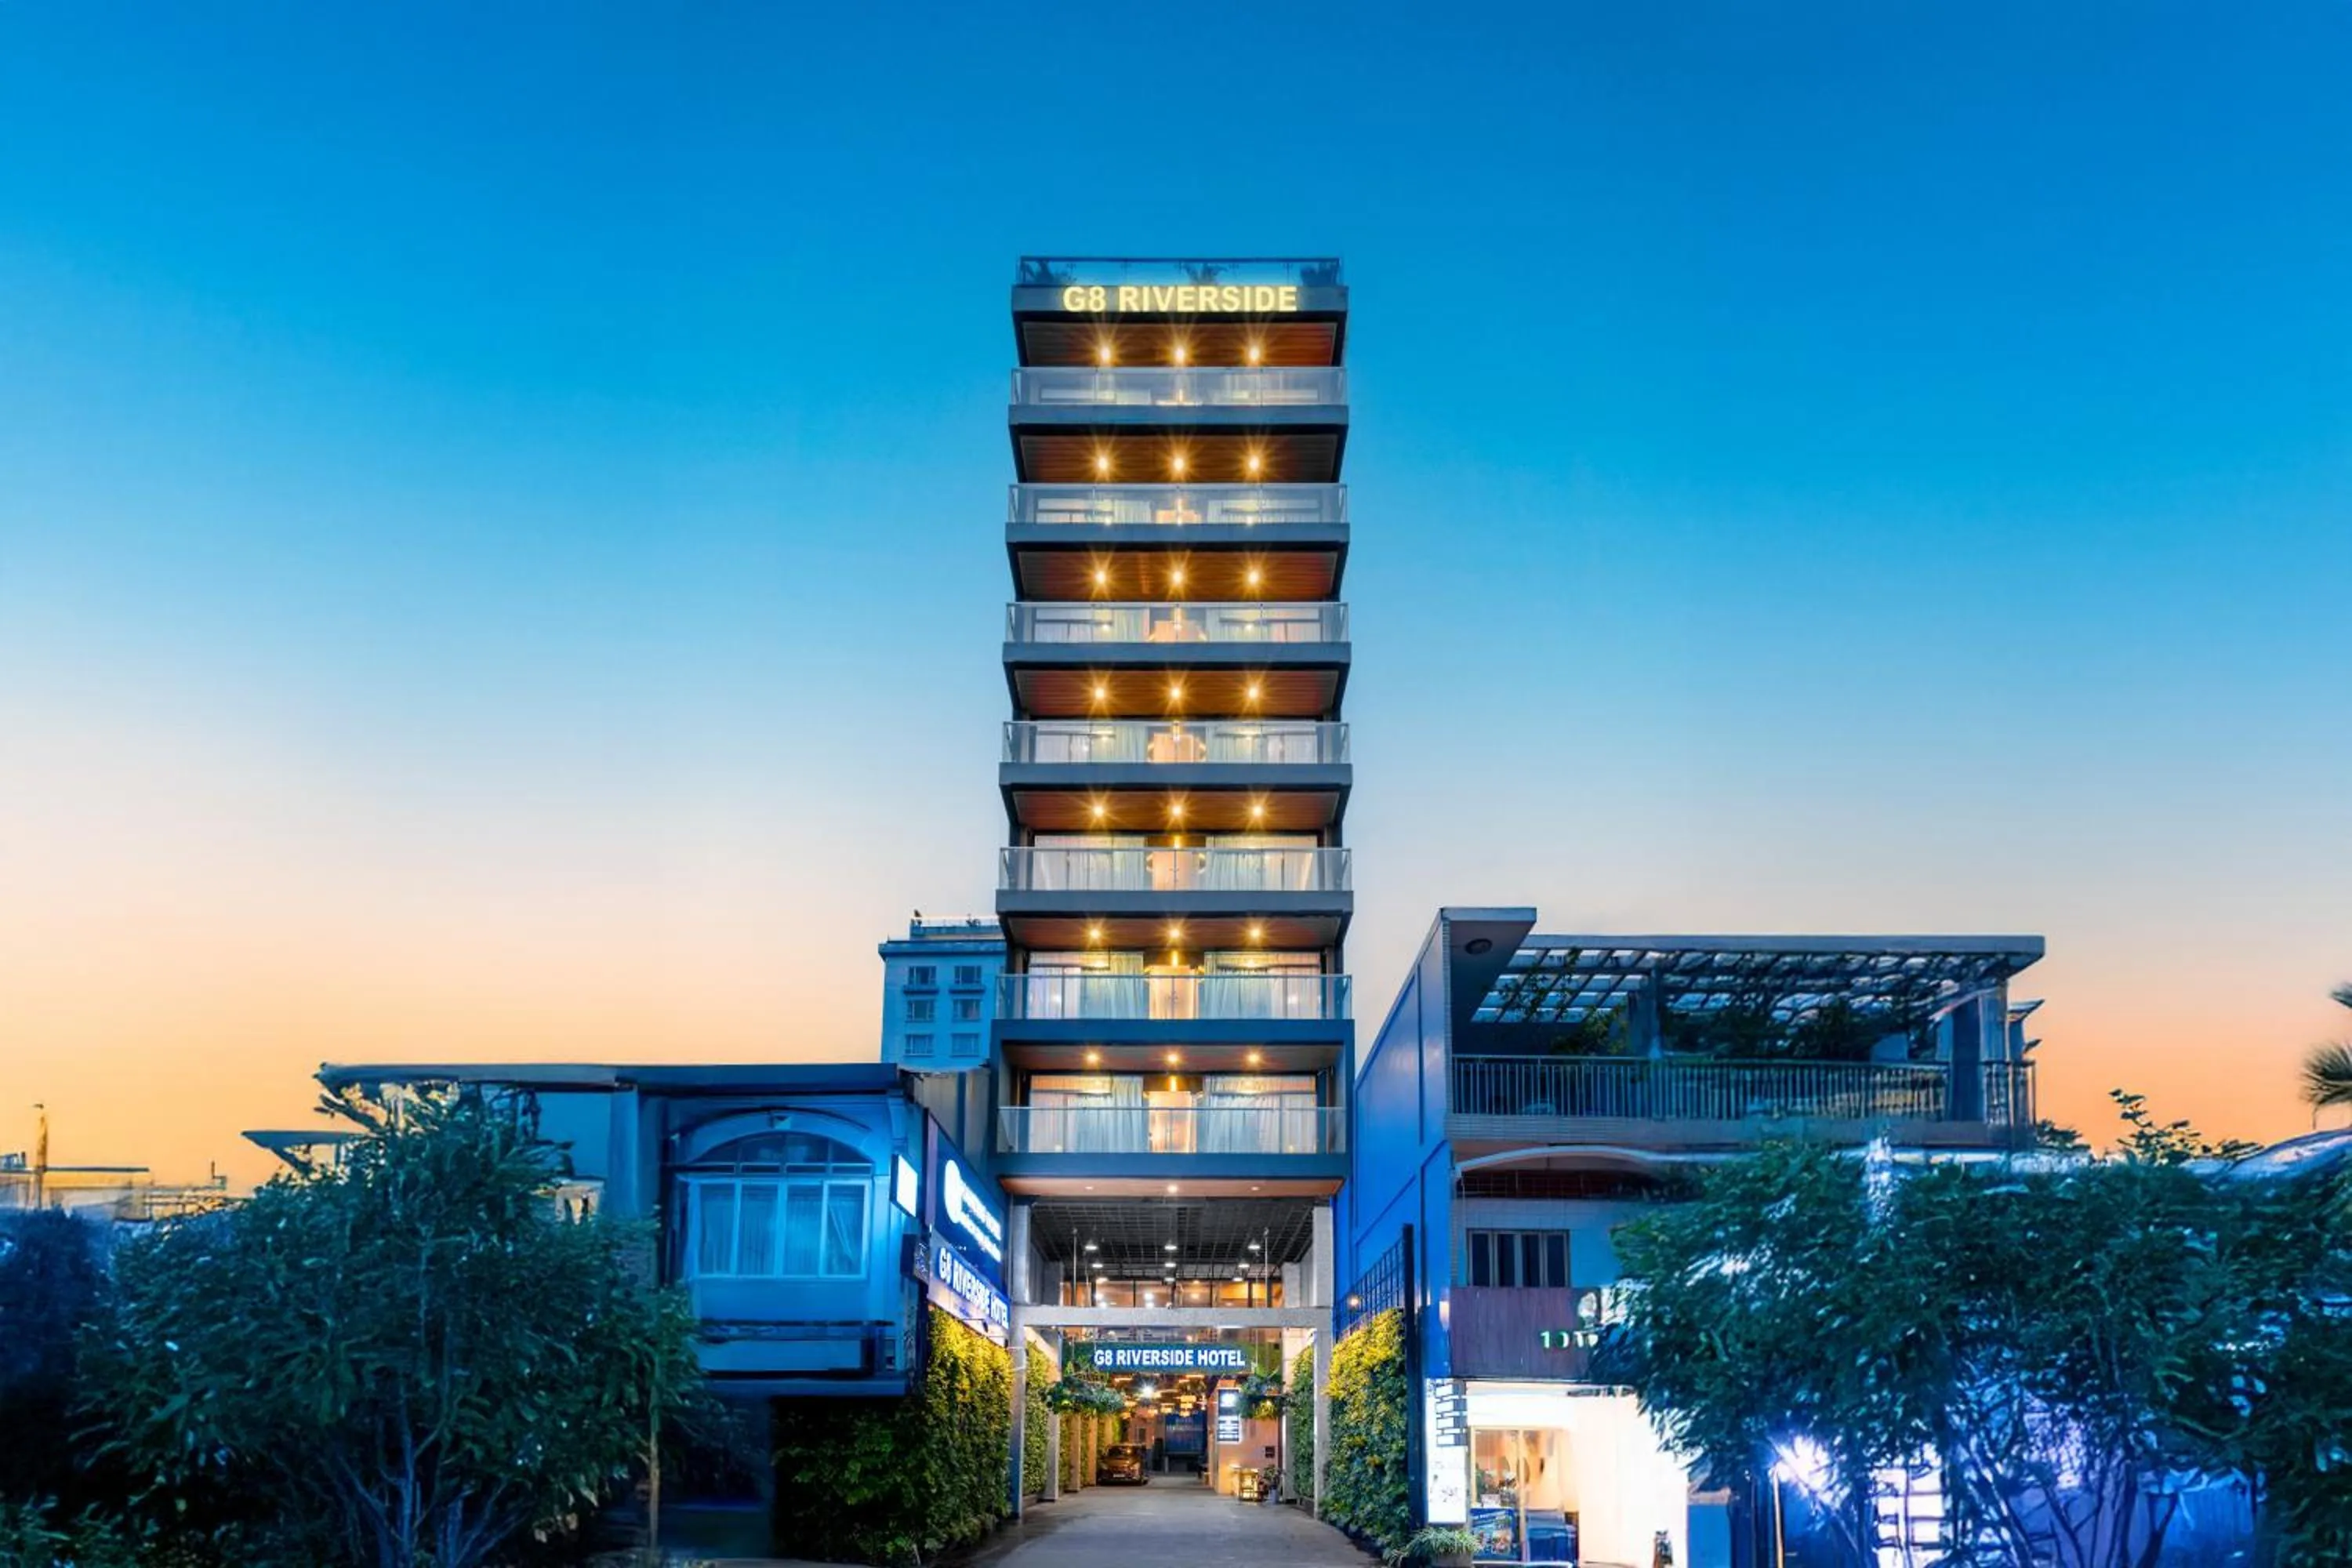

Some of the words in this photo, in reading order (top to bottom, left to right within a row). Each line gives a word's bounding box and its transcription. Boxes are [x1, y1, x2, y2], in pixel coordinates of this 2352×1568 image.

[1062, 286, 1106, 312] G8
[1119, 286, 1298, 312] RIVERSIDE
[938, 1247, 952, 1285] G8
[953, 1258, 990, 1316] RIVERSIDE
[990, 1292, 1009, 1330] HOTEL
[1094, 1349, 1112, 1366] G8
[1116, 1349, 1194, 1366] RIVERSIDE
[1197, 1349, 1246, 1366] HOTEL
